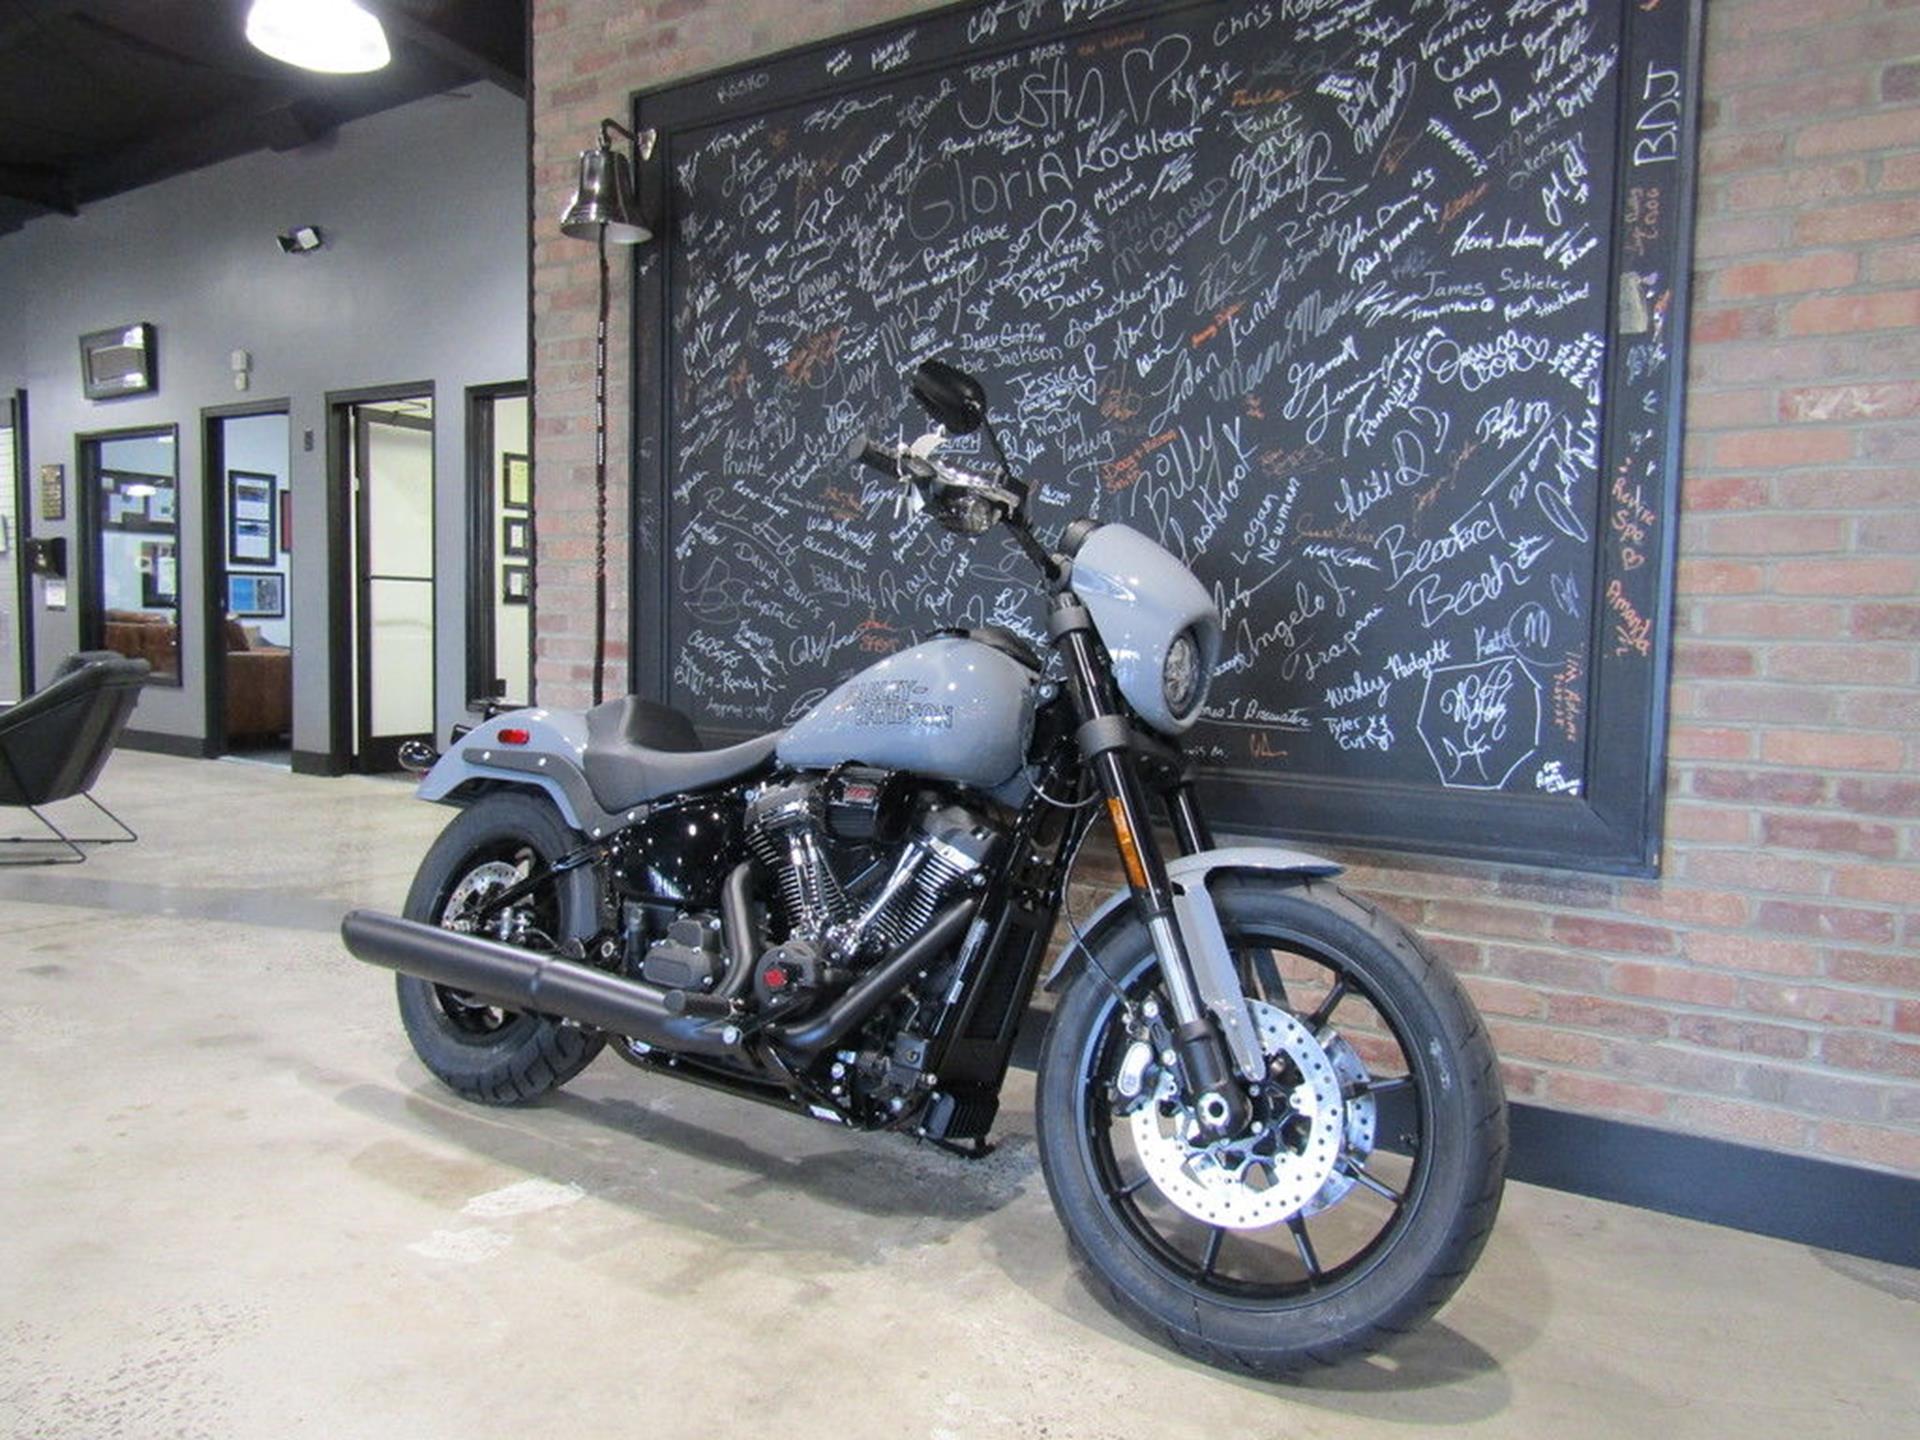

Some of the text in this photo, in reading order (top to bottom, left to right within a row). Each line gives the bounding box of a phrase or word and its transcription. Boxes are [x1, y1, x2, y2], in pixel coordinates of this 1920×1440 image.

[1213, 4, 1273, 46] Chris
[1076, 126, 1203, 178] Locklear
[1043, 278, 1106, 320] Davis
[1420, 270, 1487, 302] James
[993, 344, 1064, 368] Jackson
[1231, 493, 1279, 565] Logan
[1257, 476, 1302, 565] Newman
[1235, 581, 1326, 671] Angelo
